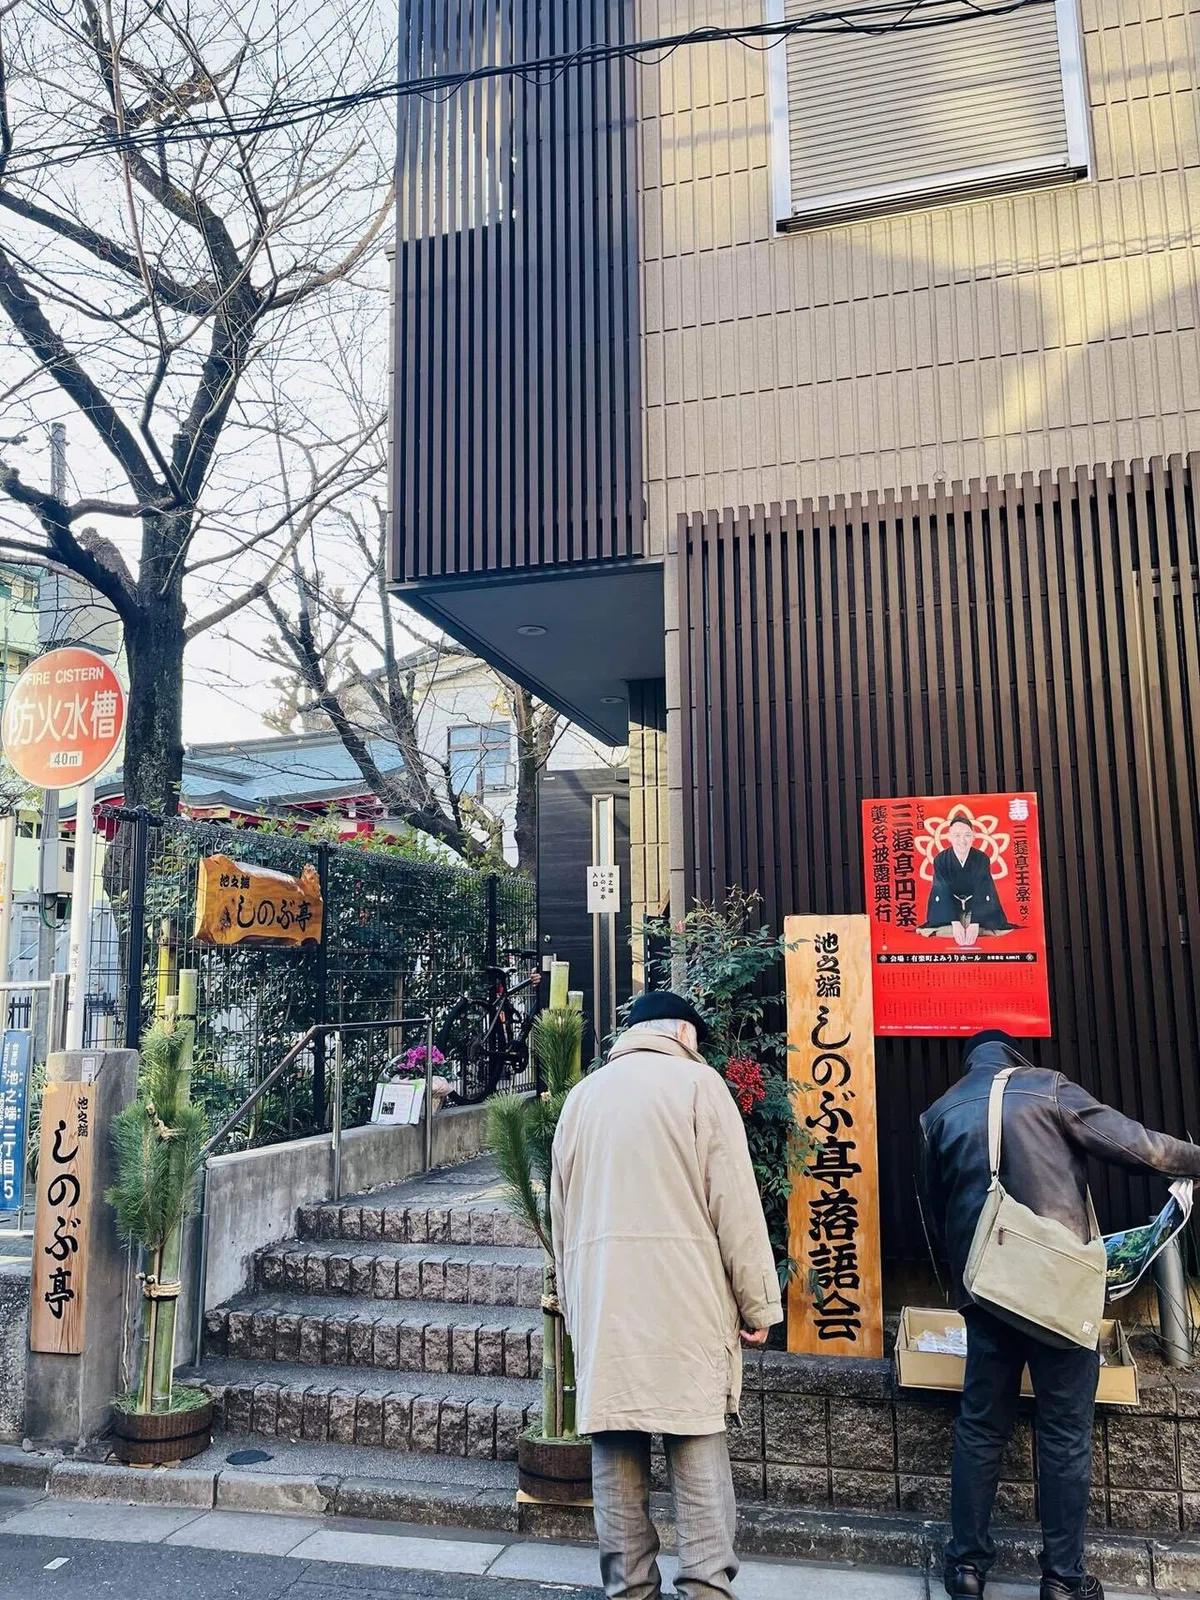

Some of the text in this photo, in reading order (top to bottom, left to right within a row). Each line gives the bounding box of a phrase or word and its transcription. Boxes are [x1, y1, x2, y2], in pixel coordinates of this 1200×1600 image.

[26, 666, 105, 686] FIRE CISTERN
[7, 688, 119, 746] 防火水槽
[219, 873, 251, 889] 池之端
[592, 872, 599, 887] 入口
[236, 894, 313, 933] しのぶ亭
[77, 1095, 89, 1138] 池之端
[44, 1119, 82, 1320] しのぶ亭
